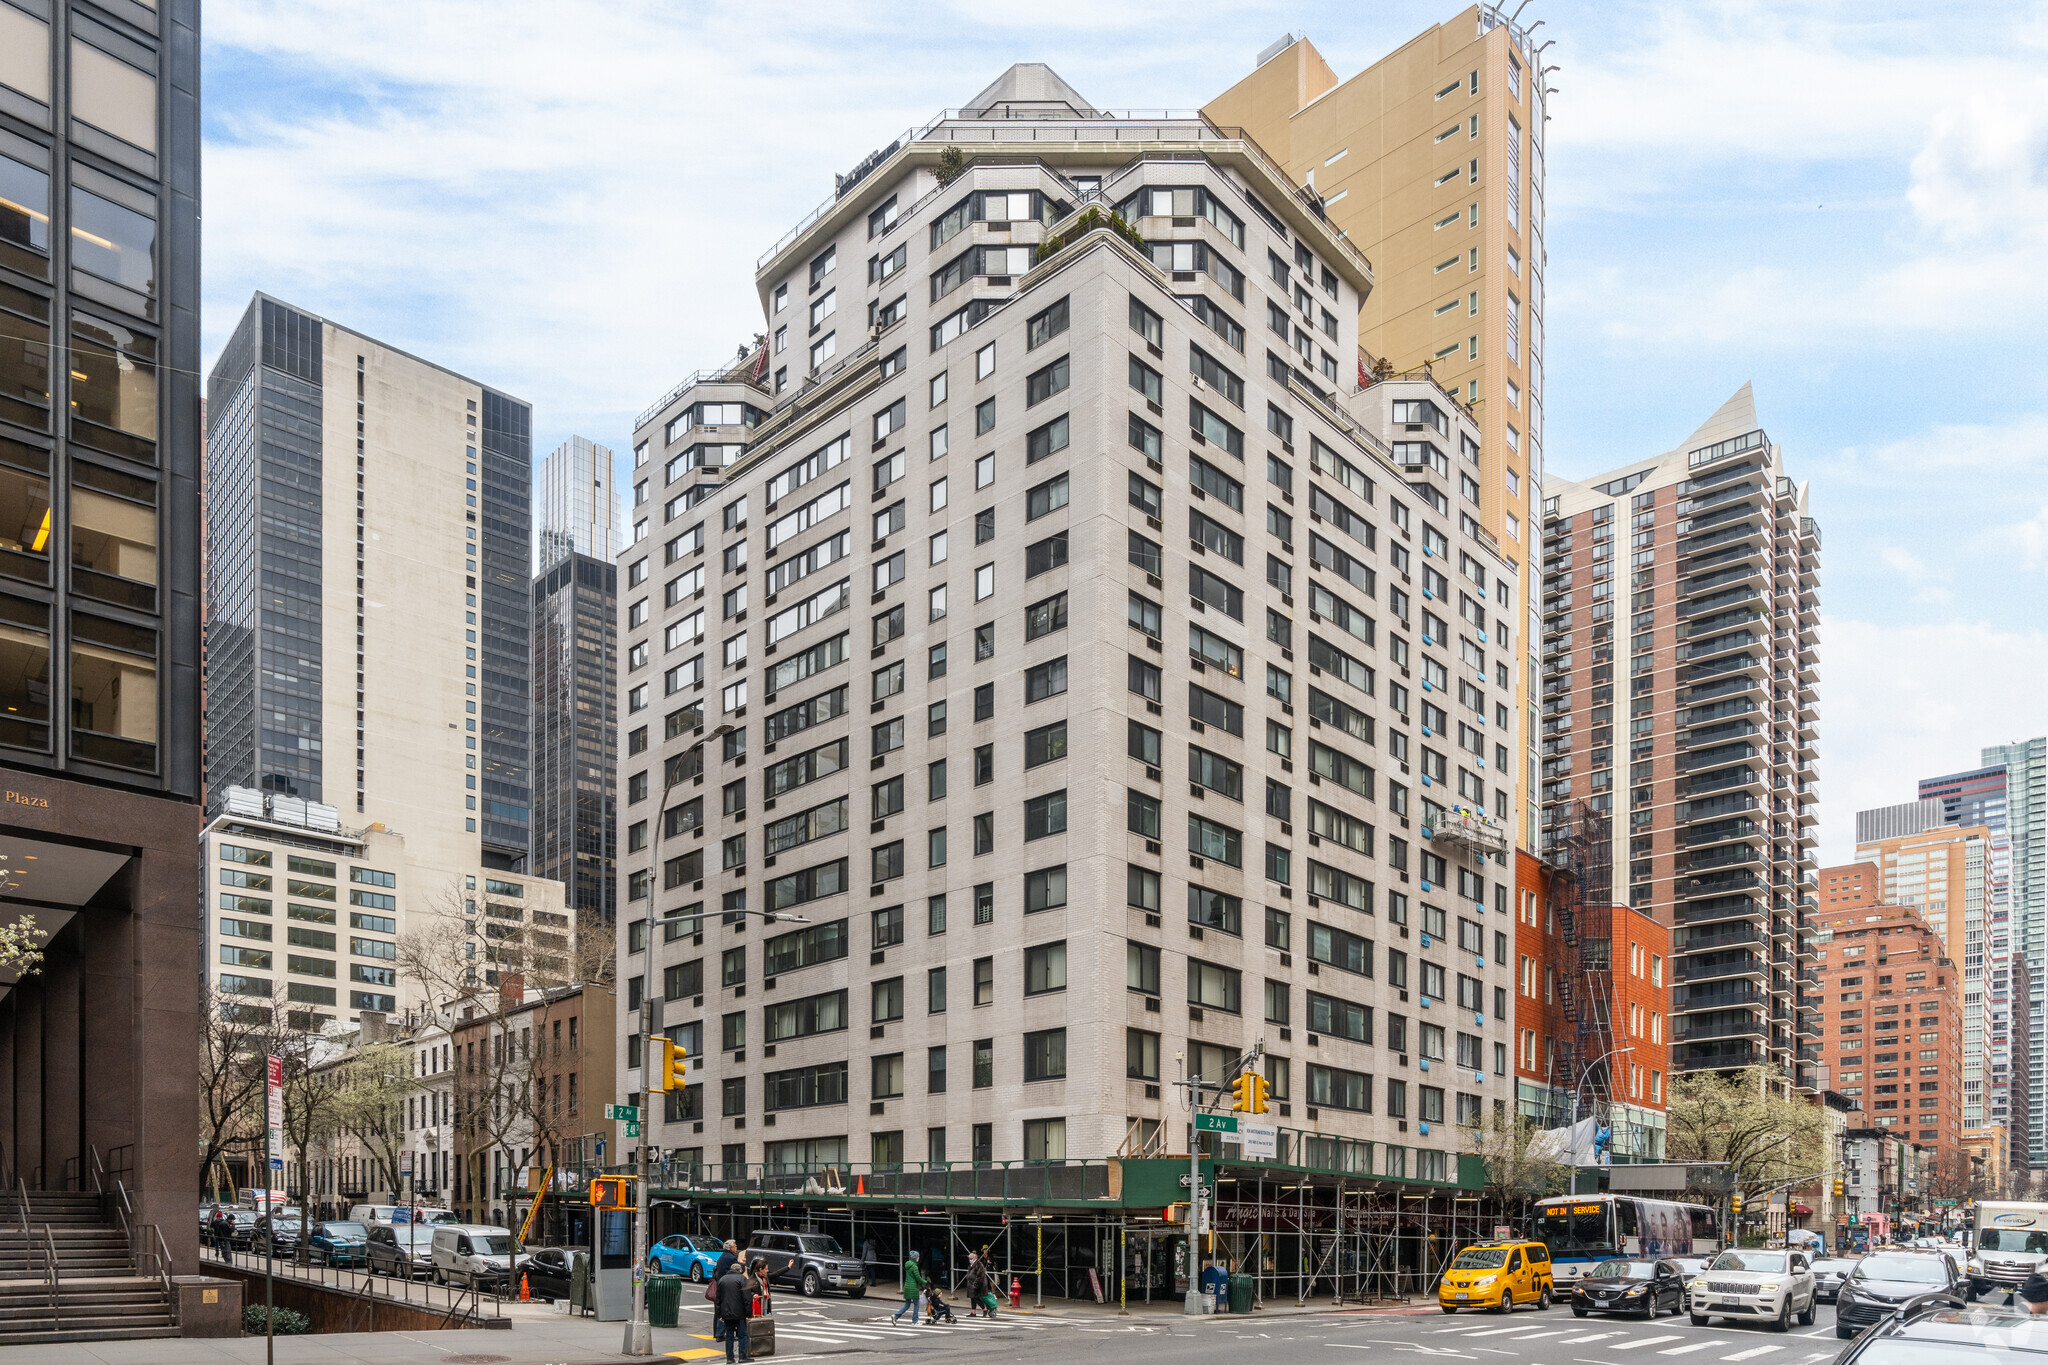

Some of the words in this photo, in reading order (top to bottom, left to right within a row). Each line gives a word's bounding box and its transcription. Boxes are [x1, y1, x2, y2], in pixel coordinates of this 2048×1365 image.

[5, 790, 49, 808] Plaza
[618, 1107, 623, 1119] 2
[1209, 1118, 1214, 1128] 2
[1216, 1119, 1226, 1129] Av
[1289, 1208, 1301, 1220] Day
[1303, 1207, 1316, 1220] Spa
[1546, 1207, 1559, 1216] NOT
[1560, 1207, 1567, 1216] IN
[1573, 1204, 1600, 1215] SERVICE
